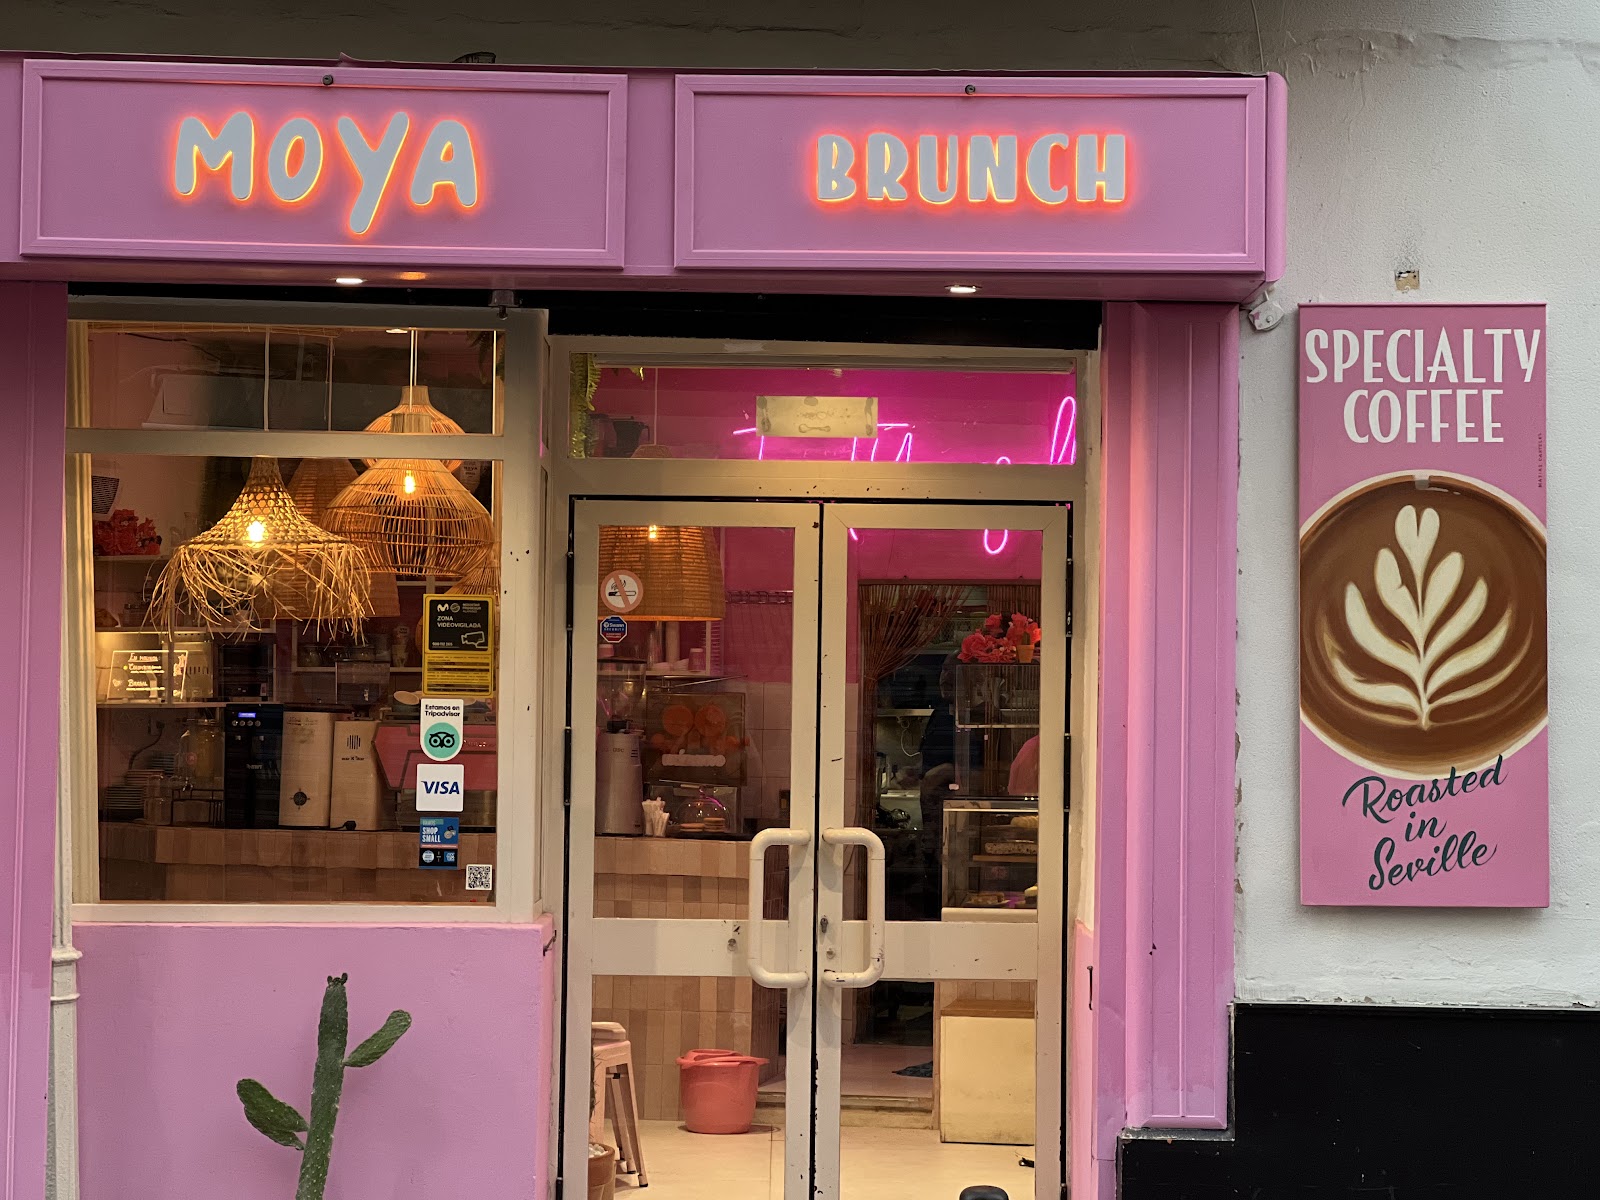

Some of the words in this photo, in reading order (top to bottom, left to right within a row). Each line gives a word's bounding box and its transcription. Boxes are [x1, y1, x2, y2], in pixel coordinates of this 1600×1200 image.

[174, 111, 478, 235] MOYA
[816, 132, 1126, 205] BRUNCH
[1305, 327, 1541, 384] SPECIALTY
[1343, 389, 1504, 443] COFFEE
[421, 781, 460, 795] VISA
[1341, 753, 1509, 824] Roasted
[422, 826, 438, 835] SHOP
[422, 834, 441, 843] SMALL
[1405, 811, 1447, 842] in
[1368, 830, 1498, 891] Seville
